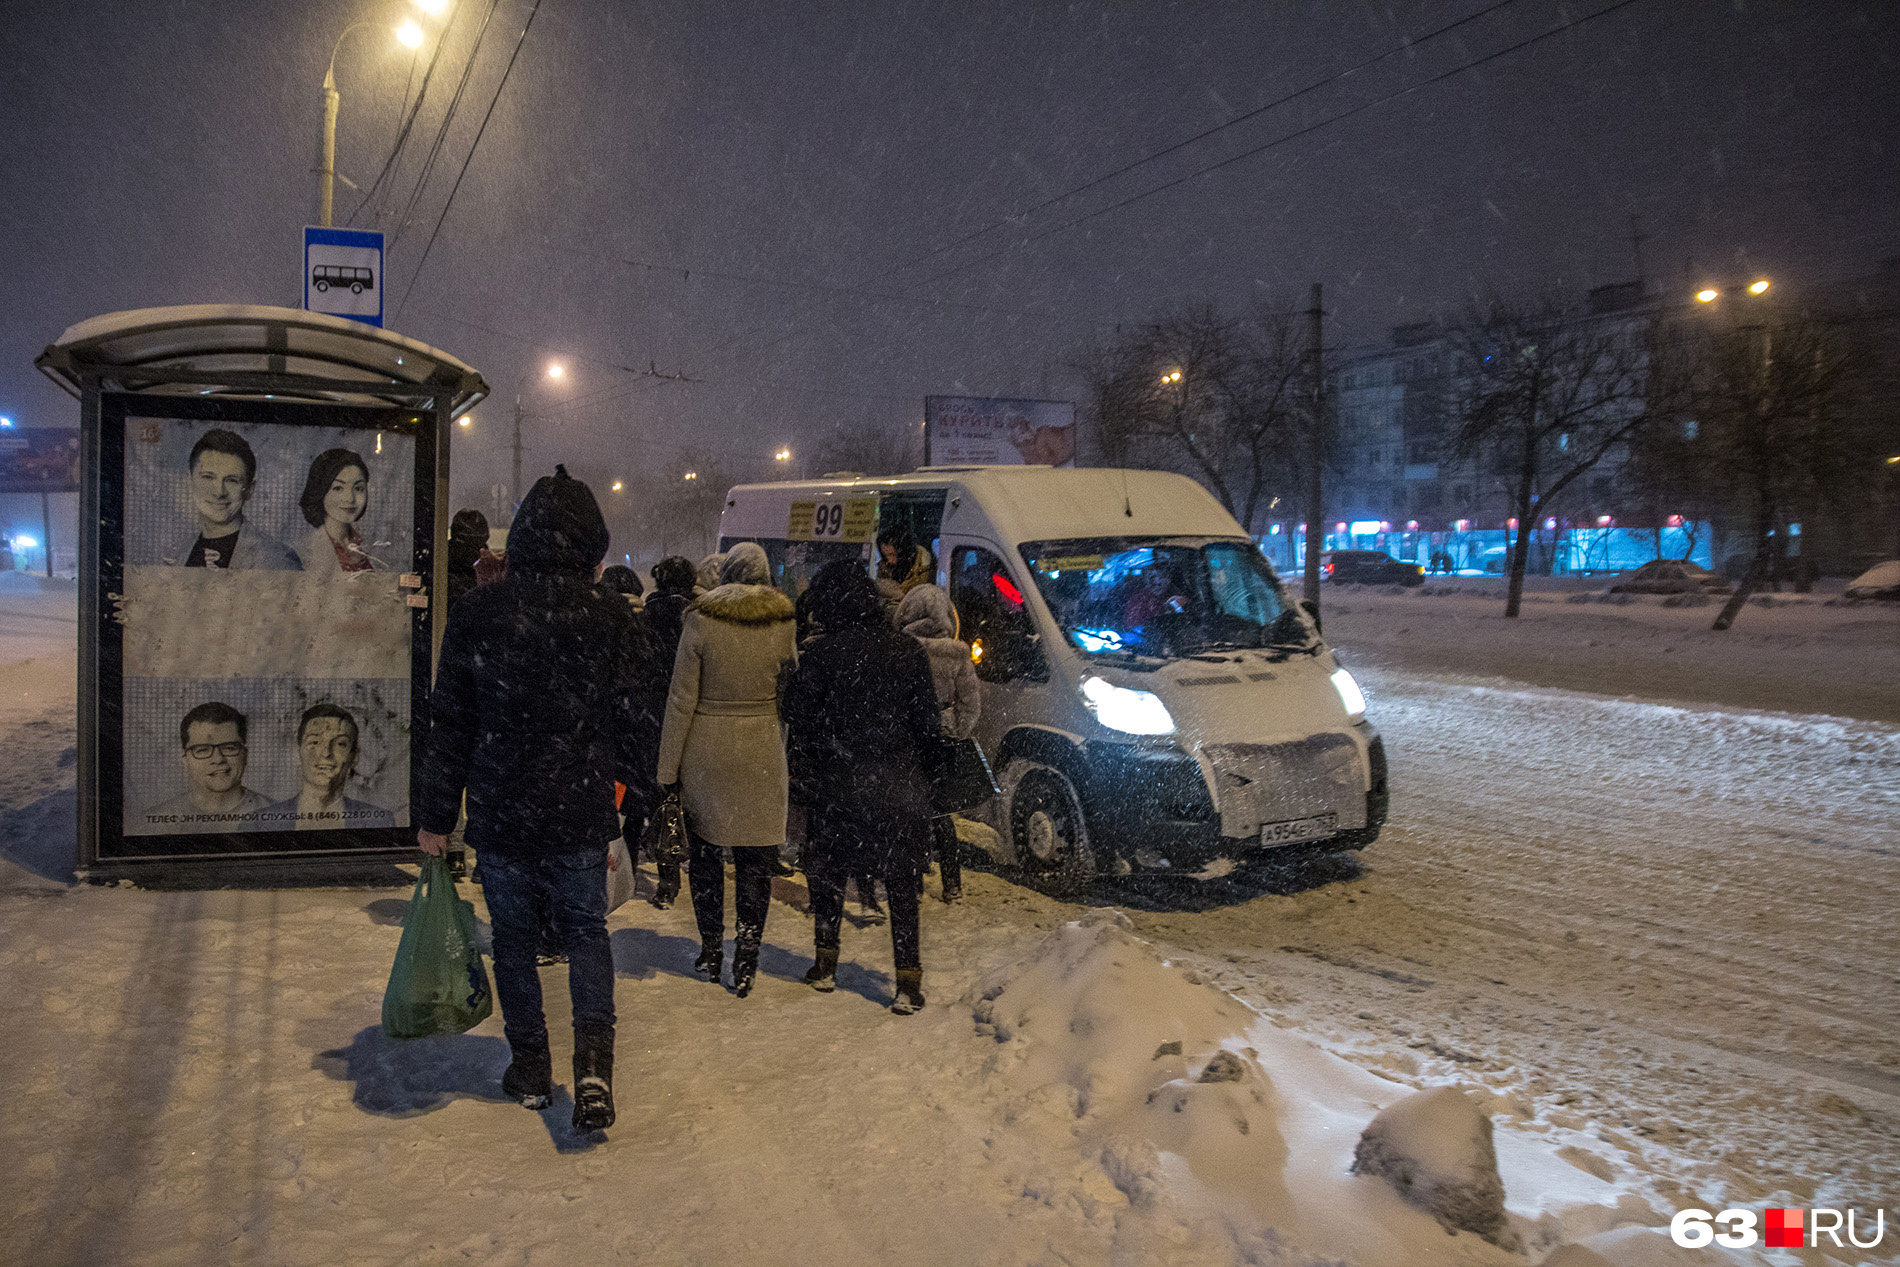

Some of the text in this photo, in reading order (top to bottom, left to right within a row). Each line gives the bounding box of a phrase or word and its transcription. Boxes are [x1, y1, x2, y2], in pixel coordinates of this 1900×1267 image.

[939, 414, 1004, 428] КУРИТЬ
[815, 504, 843, 535] 99
[196, 811, 258, 822] РЕКЛАМНОЙ
[261, 811, 306, 820] СЛУЖБЫ:
[308, 811, 314, 820] 8
[315, 810, 340, 821] (846)
[342, 810, 358, 819] 228
[360, 810, 371, 819] 00
[374, 809, 385, 818] 00
